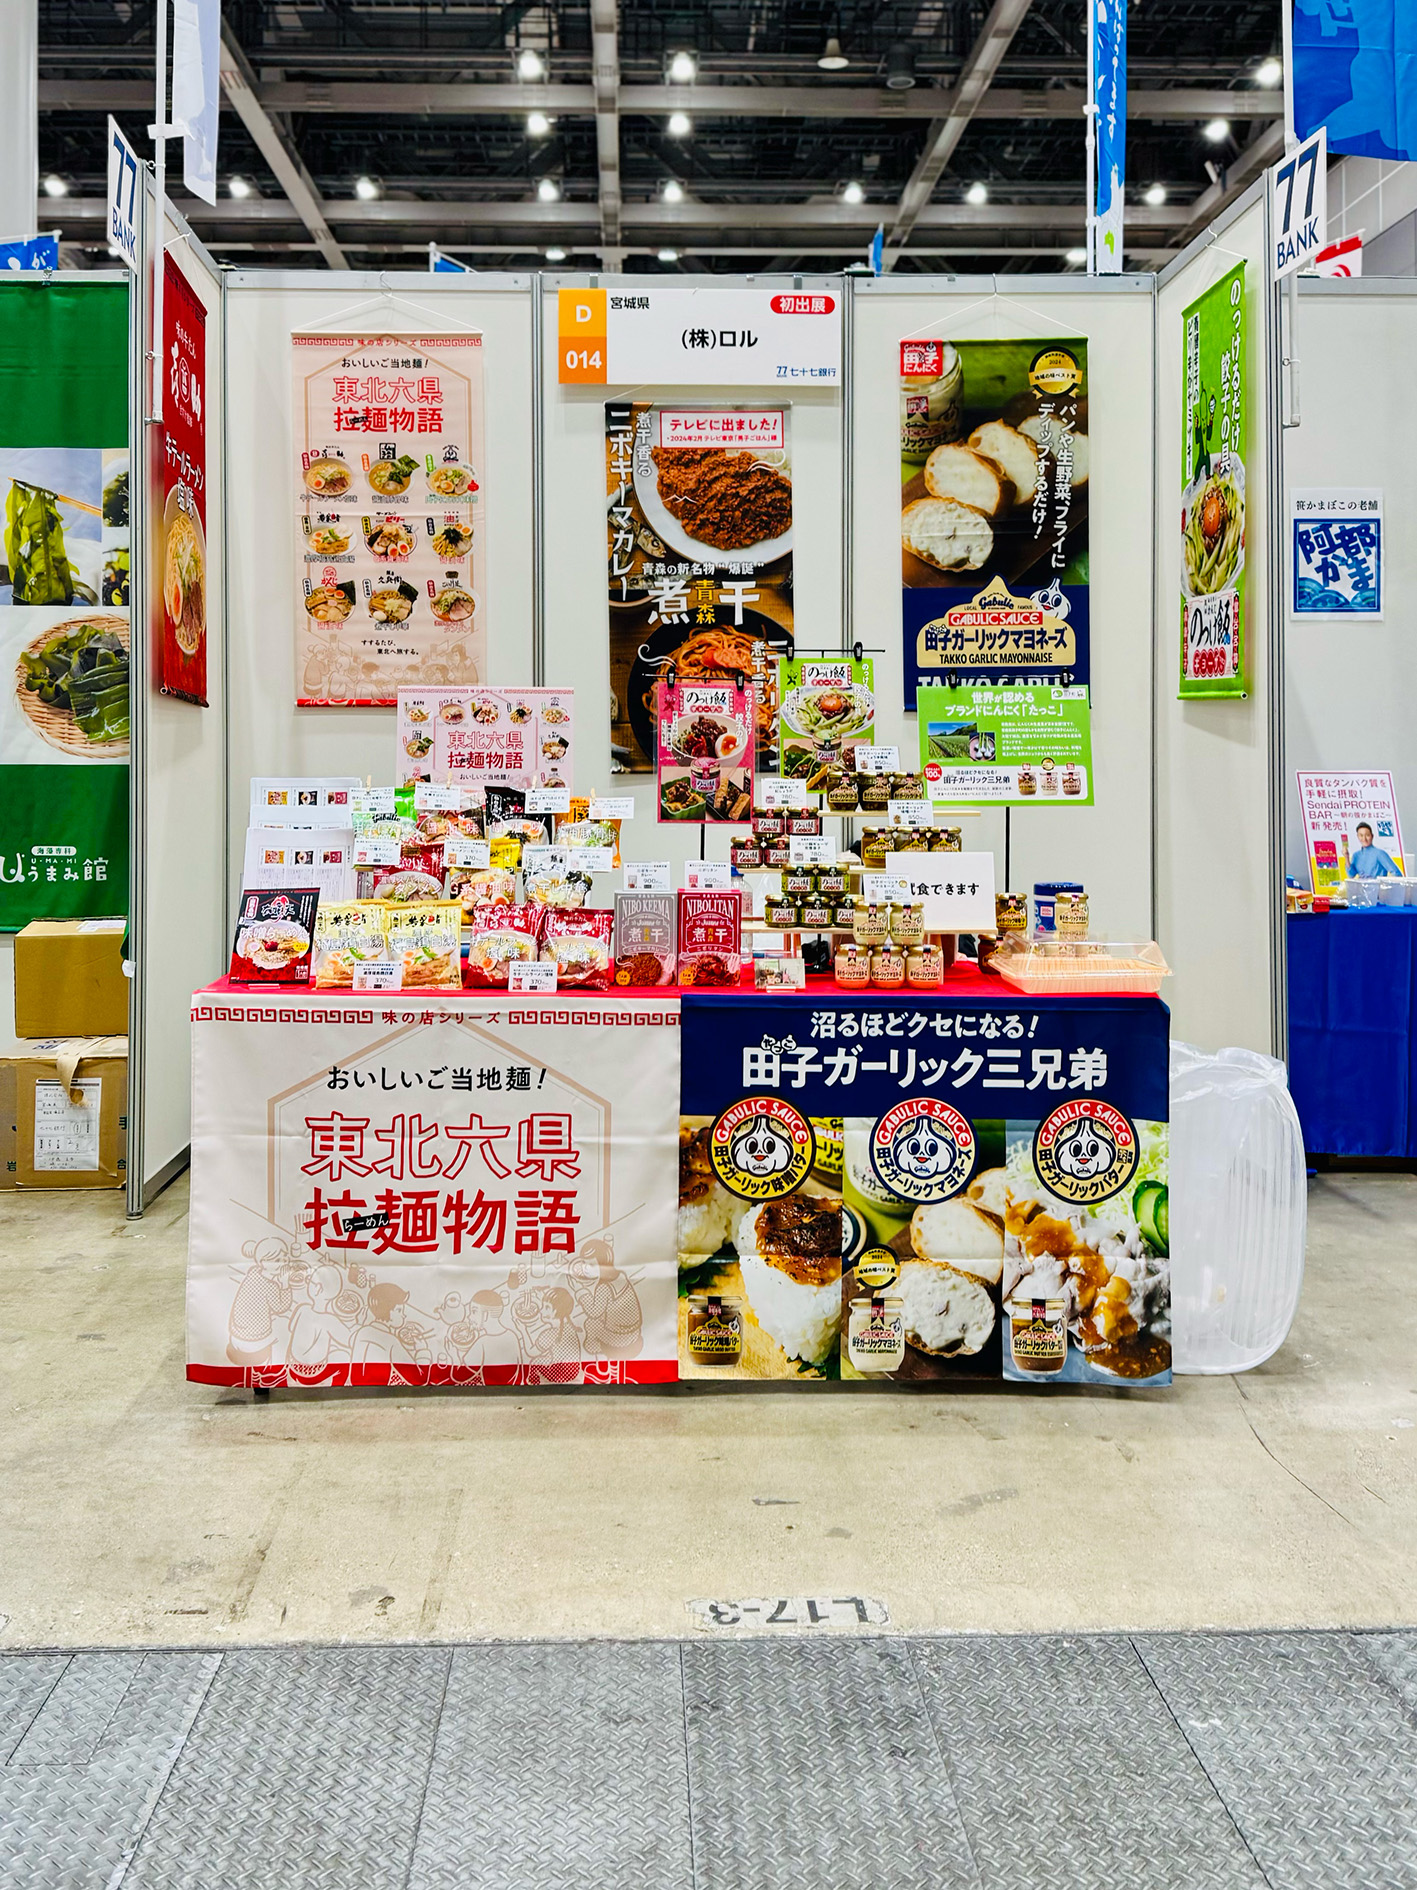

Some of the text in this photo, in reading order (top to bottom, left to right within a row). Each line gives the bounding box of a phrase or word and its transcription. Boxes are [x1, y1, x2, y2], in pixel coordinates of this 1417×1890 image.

[113, 131, 137, 226] 77
[1276, 139, 1320, 235] 77
[112, 206, 137, 263] BANK
[1277, 216, 1320, 269] BANK
[575, 305, 592, 322] D
[610, 297, 650, 310] 宮城県
[779, 297, 826, 313] 初出展
[680, 328, 759, 349] (株)ロル
[566, 350, 602, 369] 014
[776, 366, 837, 377] 77 七十七銀行
[1230, 278, 1242, 452] のっけるだけ
[332, 375, 444, 405] 東北六県
[333, 406, 444, 433] 拉麺物語
[636, 411, 652, 477] 煮干香る
[1051, 403, 1078, 568] パンや生野菜、フライに
[609, 411, 635, 601] ニボキーマカレー
[1296, 499, 1378, 511] 笹かまぼこの老舗
[978, 595, 1015, 610] Gabulic
[950, 613, 1040, 625] GABULIC SAUCE
[924, 626, 1068, 651] 田子ガーリックマヨネーズ
[939, 652, 1053, 665] TAKKO GARLIC MAYONNAISE
[971, 692, 1035, 704] 世界が認める
[447, 731, 524, 750] 東北六県
[447, 751, 524, 770] 拉麺物語
[1304, 778, 1387, 789] 良質なタンパク質を
[1307, 800, 1391, 810] Sendai PROTEIN
[1308, 811, 1333, 820] BAR
[27, 857, 109, 882] うまみ館
[622, 899, 670, 920] NIBO KEEMA
[686, 899, 735, 920] NIBOLITAN
[381, 1010, 501, 1026] 味の店シリーズ
[810, 1011, 1039, 1040] 沼るほどクセになる!
[327, 1066, 548, 1093] おいしいご当地麺!
[742, 1045, 1108, 1091] 田子ガーリック三兄弟
[716, 1100, 808, 1144] GABULIC SAUCE
[878, 1101, 971, 1146] GABULIC SAUCE
[1041, 1103, 1132, 1145] GABULIC SAUCE
[300, 1110, 582, 1182] 東北六県
[714, 1145, 807, 1196] 田子ガーリック味噌バター
[876, 1147, 973, 1198] 田子ガーリックマヨネーズ
[302, 1186, 581, 1255] 拉麺物語
[343, 1213, 389, 1233] らーめん
[708, 1596, 869, 1626] L17-3
